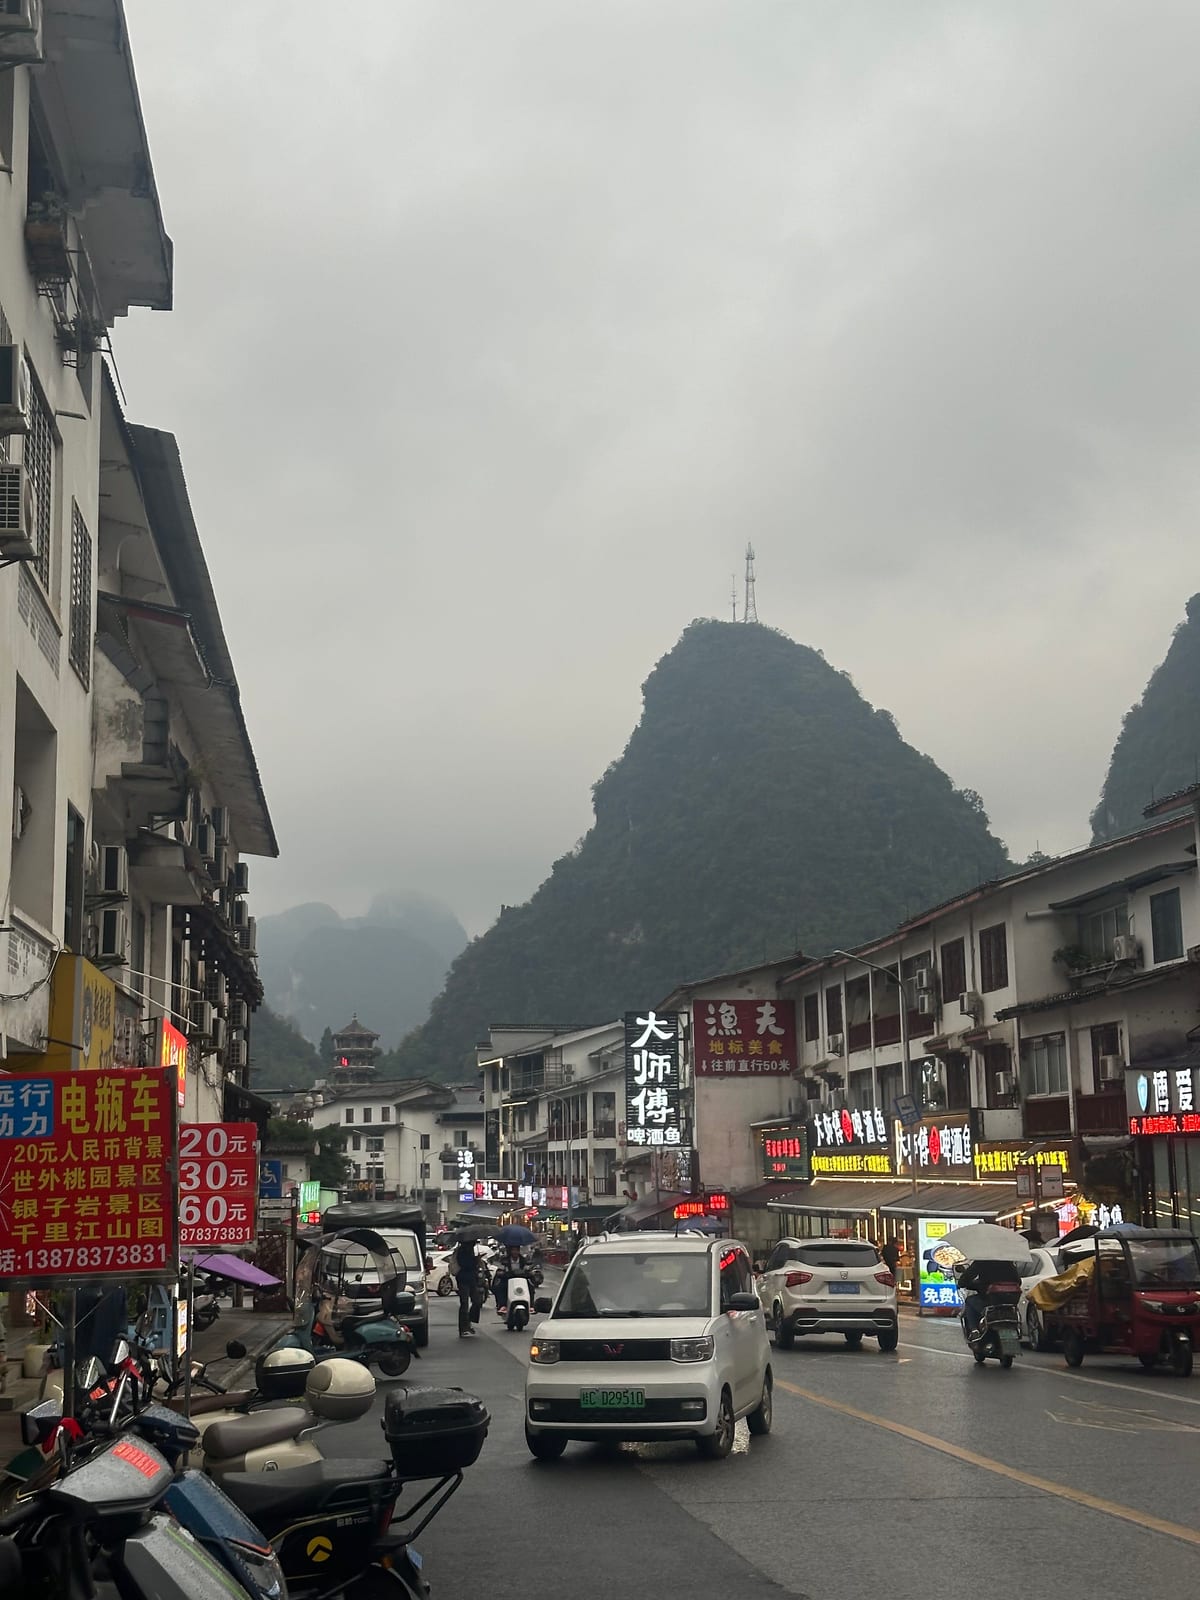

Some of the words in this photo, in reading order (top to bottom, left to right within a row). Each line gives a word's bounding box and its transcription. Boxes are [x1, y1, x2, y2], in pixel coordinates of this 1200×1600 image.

[704, 1001, 785, 1036] 渔夫
[708, 1039, 783, 1055] 地标美食
[630, 1011, 675, 1126] 大师傅
[711, 1059, 790, 1072] 往前直行50米
[61, 1074, 161, 1135] 电瓶车
[1152, 1068, 1194, 1113] 博爱
[627, 1127, 680, 1145] 啤酒鱼
[851, 1107, 888, 1144] 啤酒鱼
[14, 1136, 164, 1164] 20元人民币背景
[180, 1128, 247, 1157] 20元
[939, 1124, 972, 1166] 啤酒鱼
[11, 1164, 163, 1192] 世外桃园景区
[180, 1161, 248, 1191] 30元
[11, 1193, 163, 1220] 银子岩景区
[180, 1196, 247, 1225] 60元
[11, 1217, 163, 1244] 千里江山图
[181, 1227, 251, 1241] 878373831
